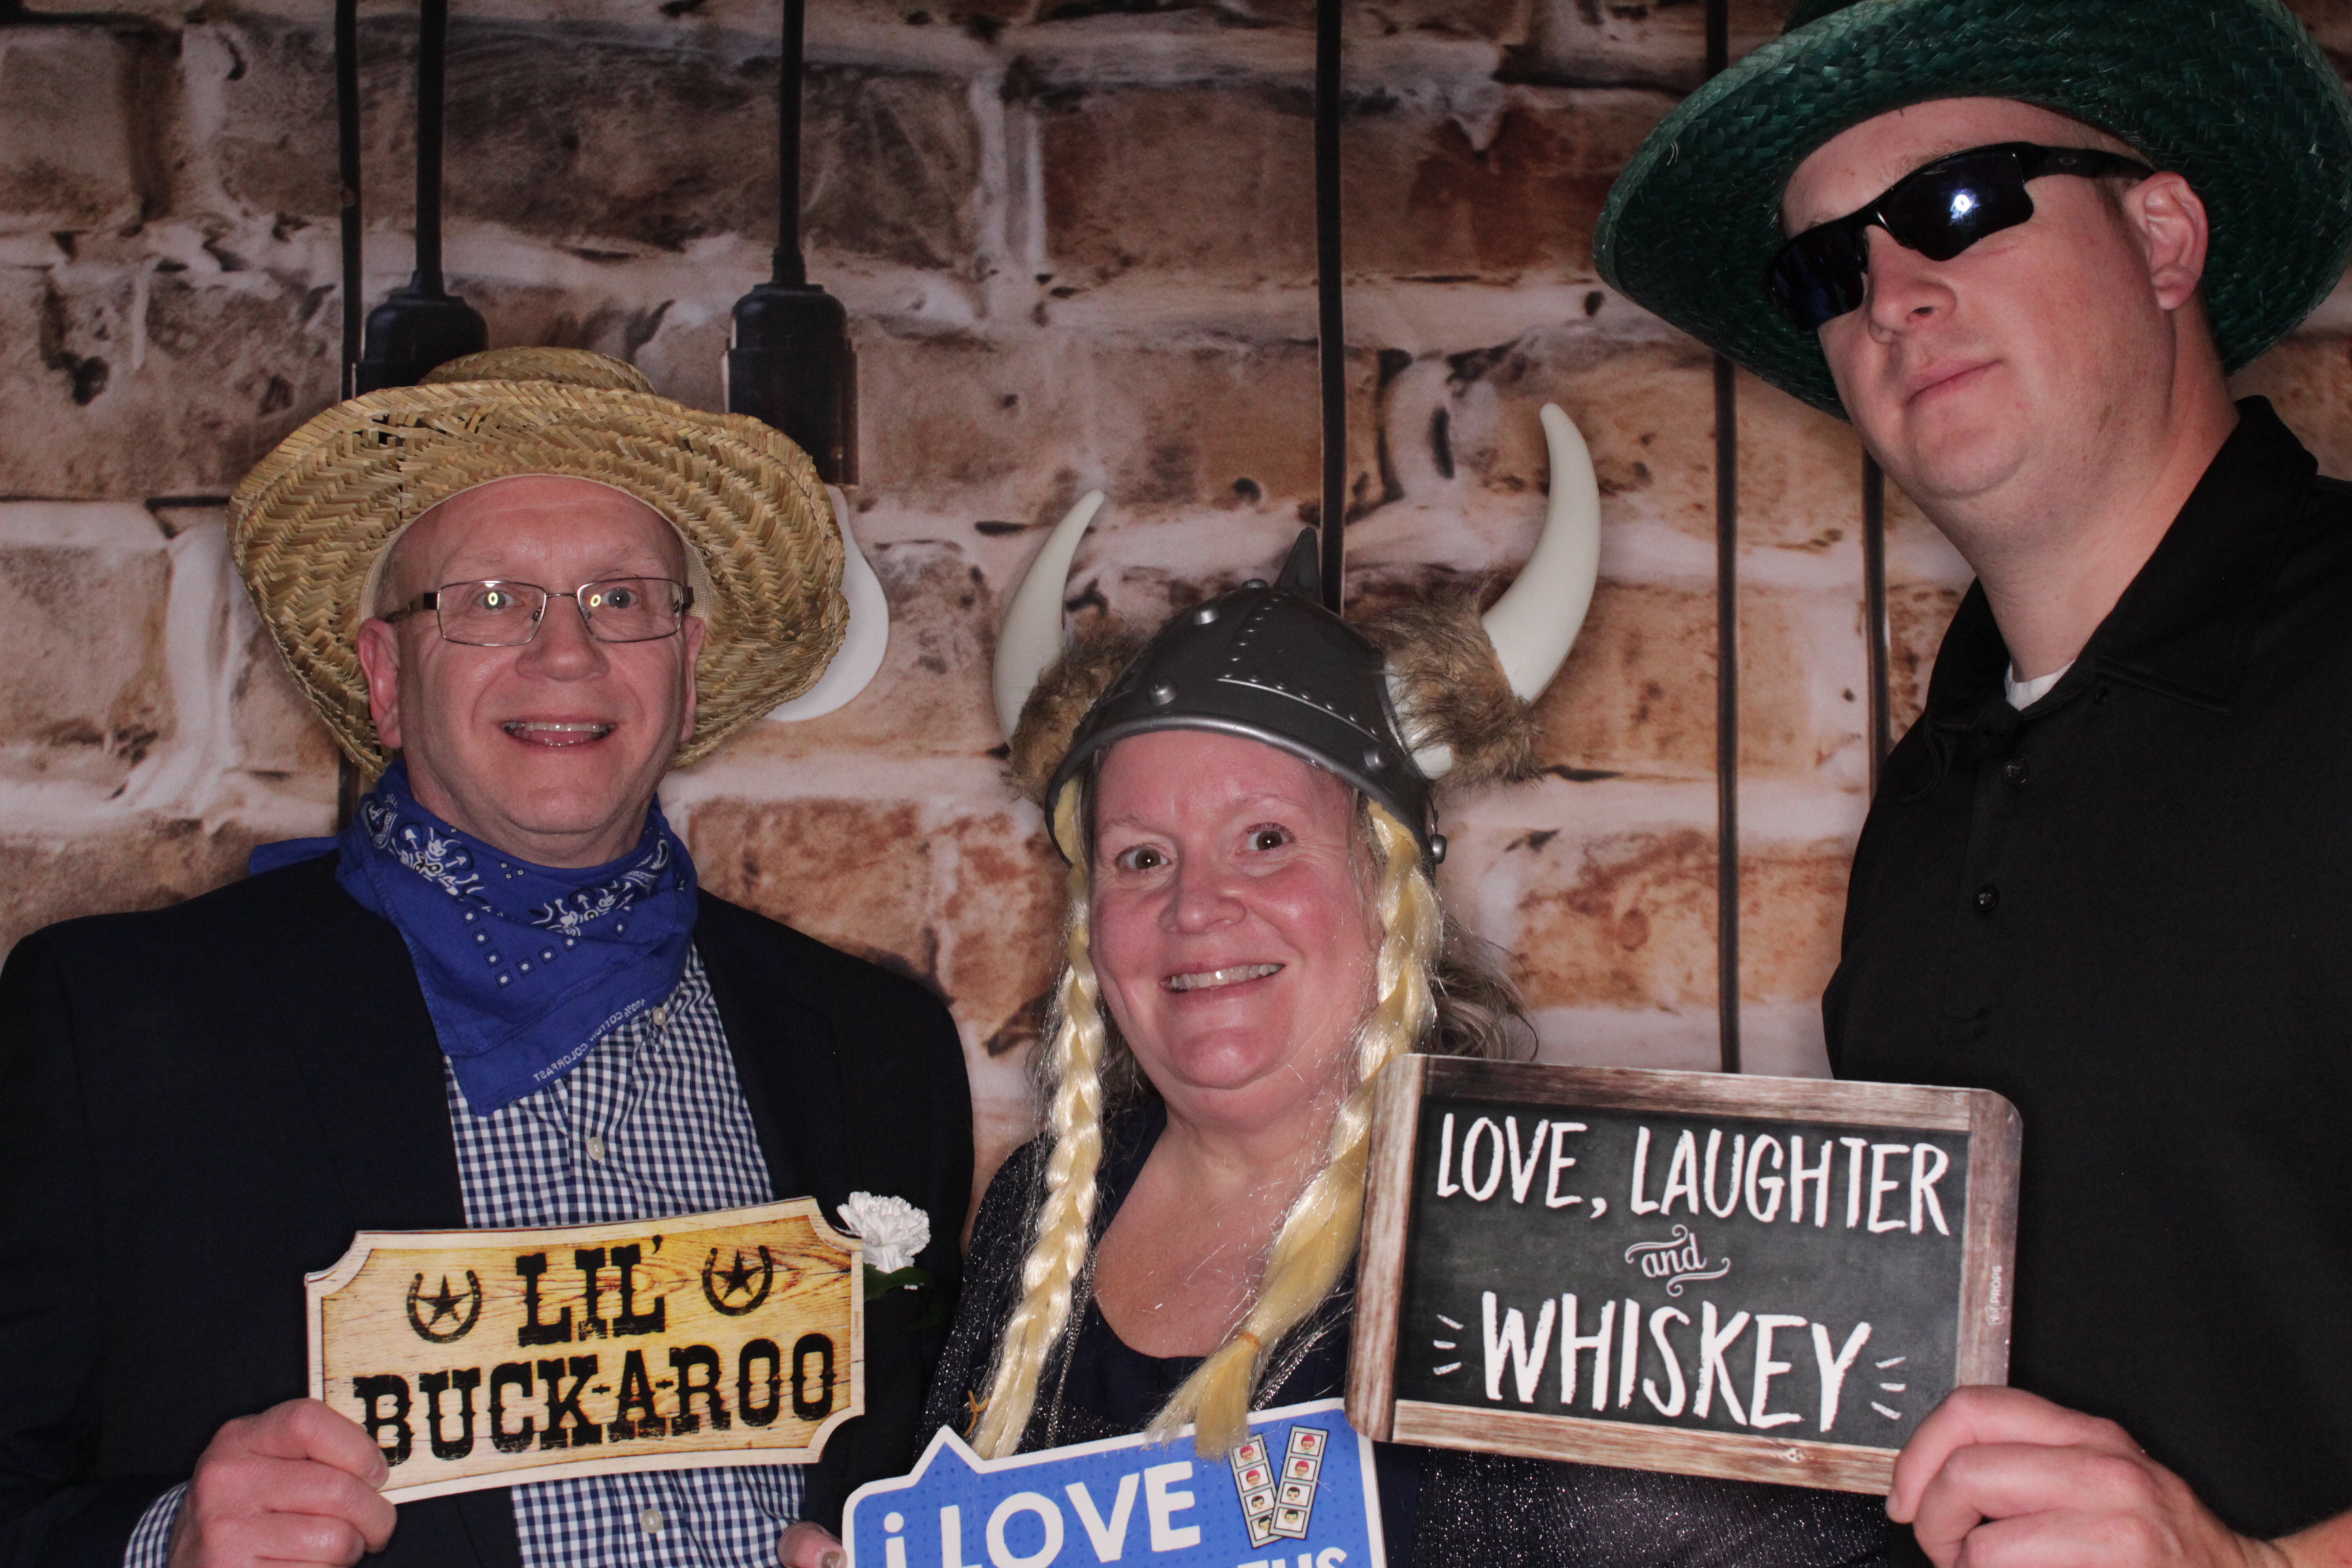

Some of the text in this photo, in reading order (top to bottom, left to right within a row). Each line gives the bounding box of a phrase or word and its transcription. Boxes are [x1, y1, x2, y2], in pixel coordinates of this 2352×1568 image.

[1437, 1112, 1950, 1236] LOVE, LAUGHTER
[515, 1234, 666, 1348] LIL'
[1641, 1232, 1708, 1279] and
[1989, 1265, 2004, 1304] PROPS
[353, 1332, 837, 1468] BUCK-A-ROO
[1482, 1290, 1872, 1433] WHISKEY
[940, 1460, 1201, 1568] LOVE
